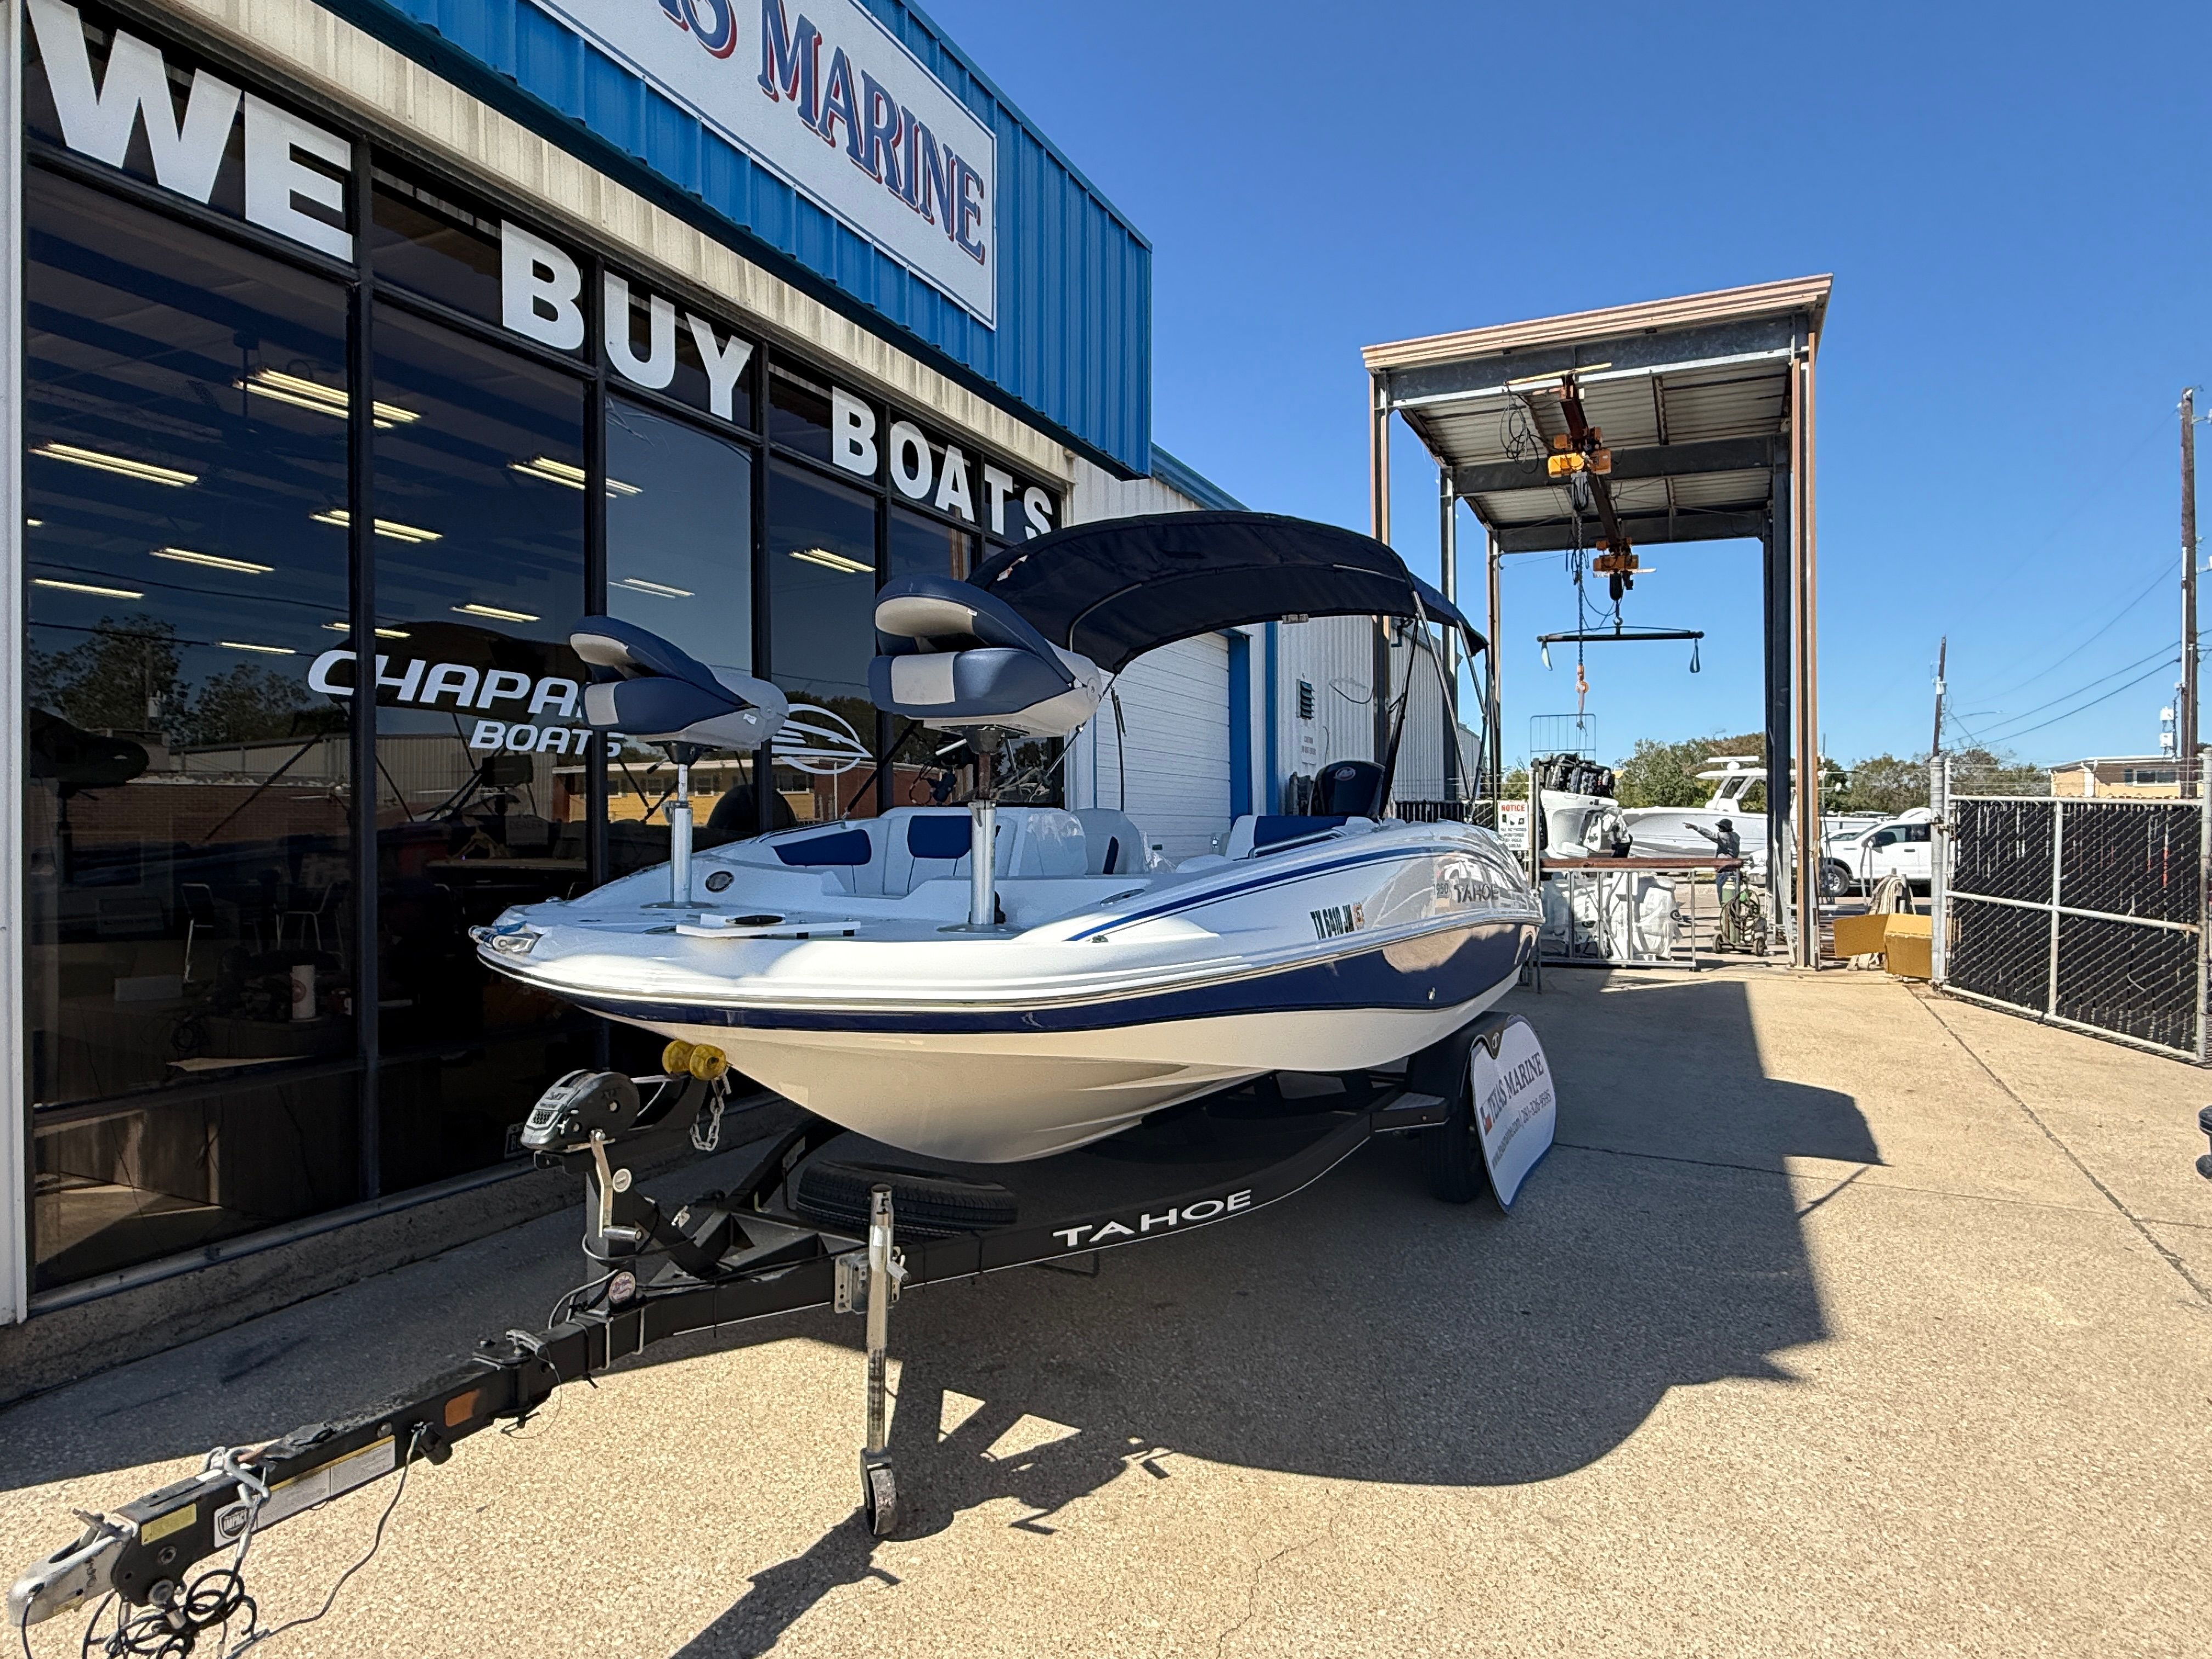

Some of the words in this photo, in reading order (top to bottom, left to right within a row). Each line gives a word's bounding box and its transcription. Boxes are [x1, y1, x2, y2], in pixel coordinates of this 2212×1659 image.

[757, 0, 986, 266] MARINE
[26, 0, 353, 264] WE
[501, 219, 754, 421] BUY
[832, 386, 1052, 540] BOATS
[308, 650, 583, 718] CHAPA
[470, 720, 624, 758] BOATS
[1500, 804, 1526, 812] NOTICE
[1454, 883, 1499, 903] TAHOE
[1310, 910, 1326, 940] TX
[1487, 1079, 1507, 1124] TEXAS
[1504, 1052, 1544, 1099] MARINE
[1052, 1189, 1252, 1247] TAHOE
